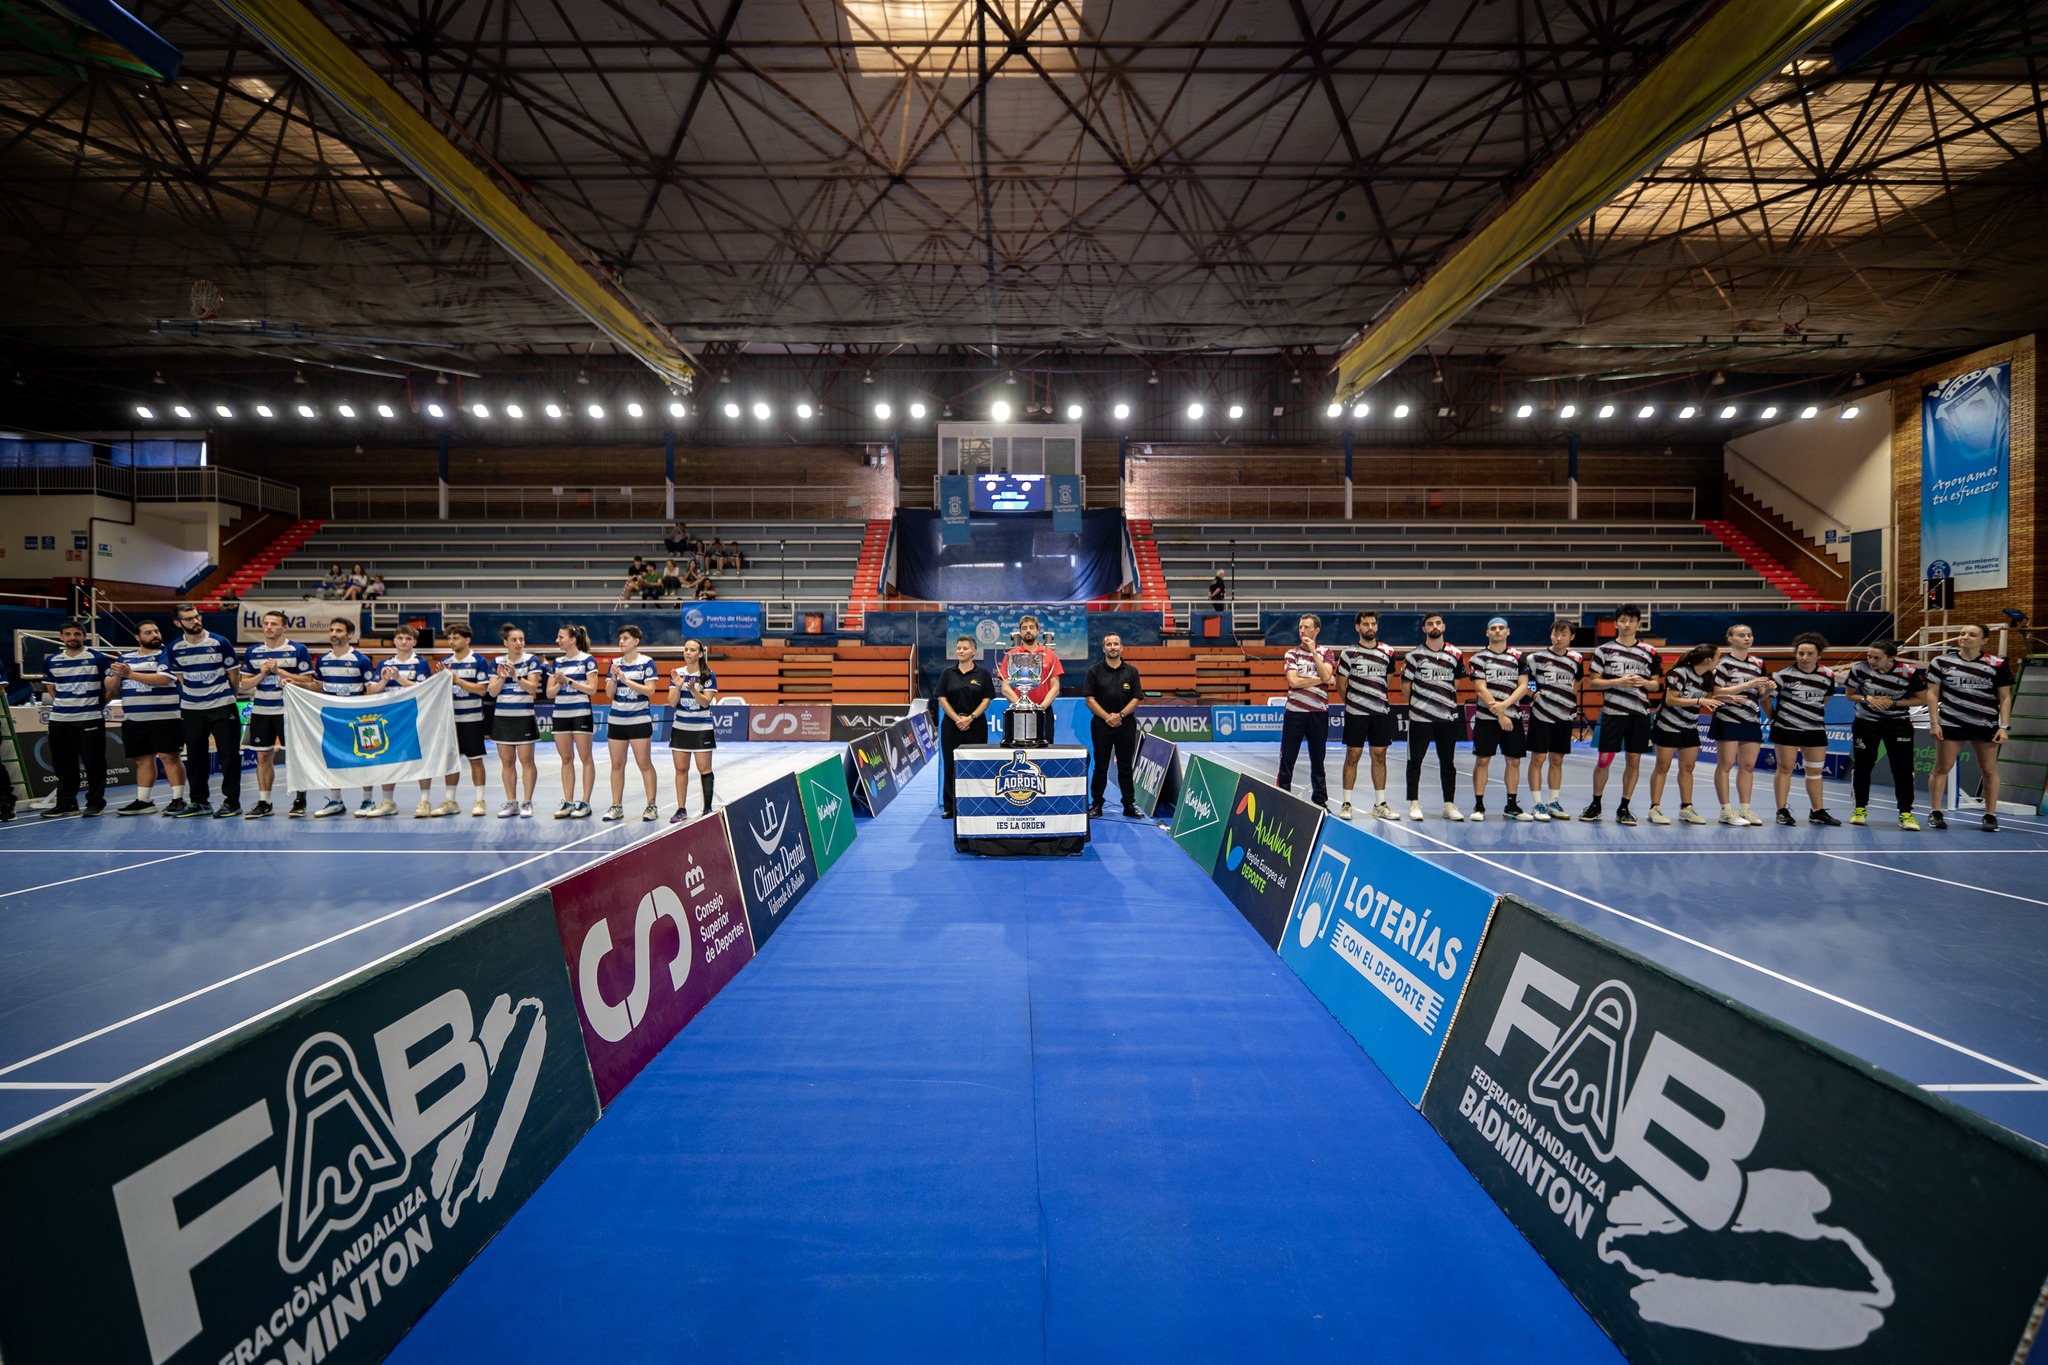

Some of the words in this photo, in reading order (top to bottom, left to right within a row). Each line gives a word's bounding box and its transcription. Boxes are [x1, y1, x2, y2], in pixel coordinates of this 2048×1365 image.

[1932, 466, 1997, 496] Apoyamos
[1932, 495, 1947, 505] tu
[1950, 481, 1998, 505] esfuerzo
[1952, 557, 1998, 567] Ayuntamiento
[244, 611, 306, 628] Huva
[1162, 717, 1208, 732] YONEX
[1240, 711, 1284, 722] LOTERÍA
[1252, 810, 1295, 867] Andalucía
[754, 860, 784, 902] Clínica
[780, 832, 806, 877] Dental
[1241, 863, 1266, 894] DEPORTE
[1246, 848, 1260, 867] Región
[1259, 859, 1278, 882] Europea
[1277, 874, 1287, 889] del
[695, 892, 724, 922] Consejo
[700, 911, 730, 942] Superior
[705, 946, 715, 963] de
[714, 922, 744, 955] Deportes
[1344, 876, 1462, 981] LOTERÍAS
[1342, 934, 1362, 959] CON
[1363, 950, 1373, 971] EL
[1375, 960, 1425, 1012] DEPORTE
[1485, 952, 1766, 1231] FAB
[112, 988, 488, 1365] FAB
[1459, 1085, 1595, 1240] BÁDMINTON
[1534, 1126, 1606, 1203] ANDALUZA
[332, 1186, 427, 1288] ANDALUZA
